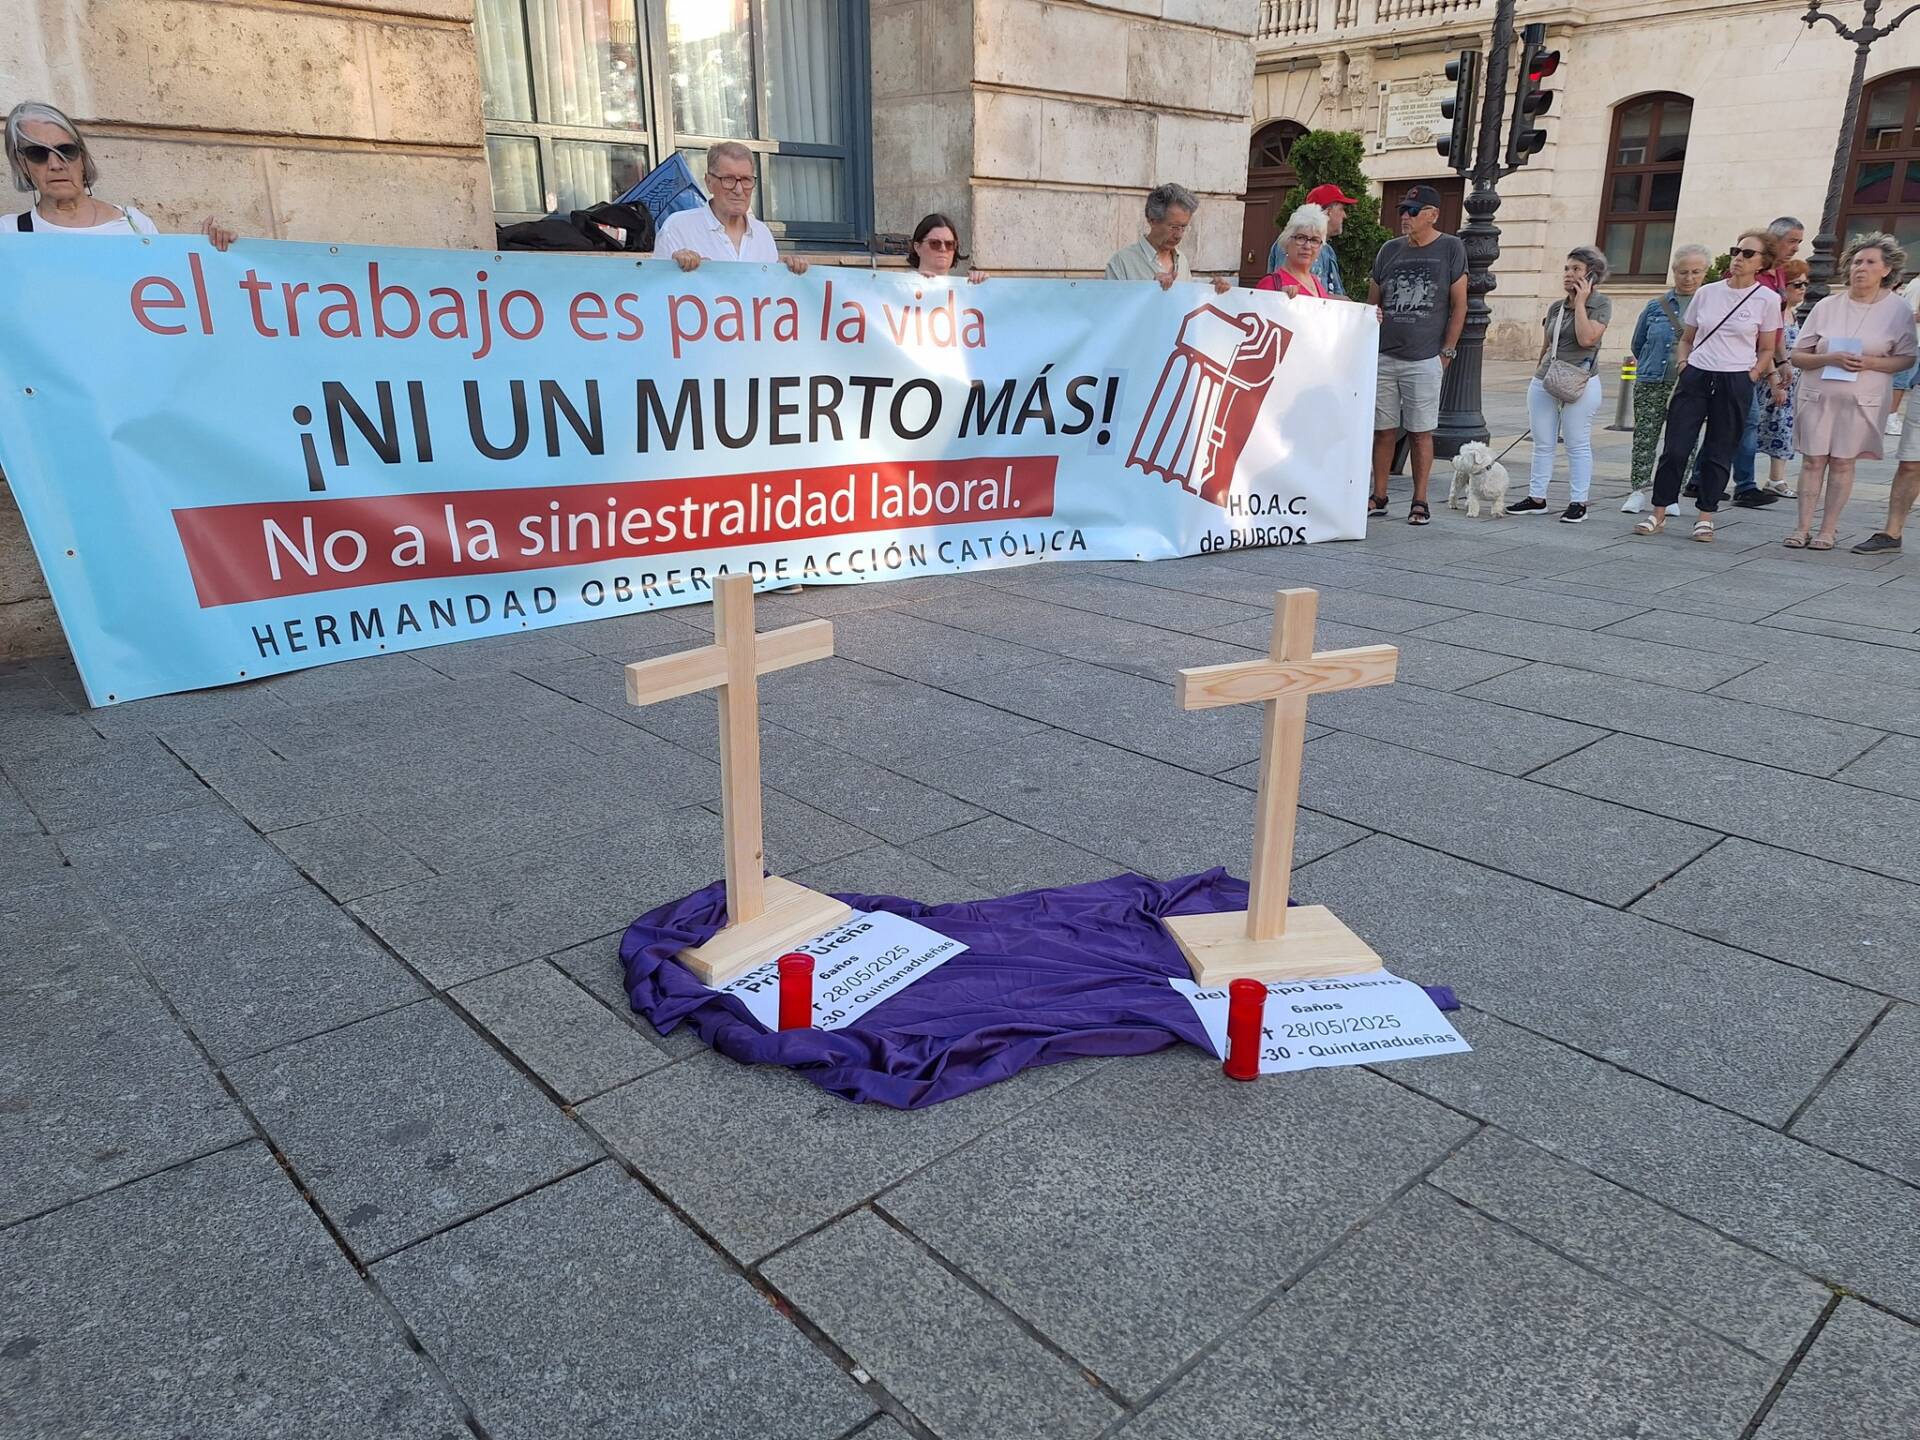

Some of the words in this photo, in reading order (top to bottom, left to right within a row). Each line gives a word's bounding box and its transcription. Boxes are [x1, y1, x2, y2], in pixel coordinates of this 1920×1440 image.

[130, 252, 215, 336] el
[239, 262, 544, 360] trabajo
[569, 291, 645, 341] es
[668, 291, 799, 359] para
[820, 281, 866, 344] la
[882, 289, 987, 348] vida
[293, 380, 434, 492] ¡NI
[463, 379, 605, 460] UN
[635, 375, 943, 453] MUERTO
[958, 363, 1119, 446] MÁS!
[1229, 494, 1307, 516] H.O.A.C.
[262, 516, 368, 581] No
[391, 525, 426, 567] a
[444, 504, 500, 563] la
[519, 474, 856, 556] siniestralidad
[870, 465, 1022, 519] laboral.
[1200, 529, 1225, 552] de
[1229, 526, 1307, 550] BURGOS
[251, 586, 558, 658] HERMANDAD
[748, 558, 790, 585] DE
[803, 541, 927, 578] ACCIÓN
[938, 529, 1087, 564] CATÓLICA
[809, 923, 874, 955] Ureña
[819, 954, 860, 980] 6años
[822, 945, 911, 1003] 28/05/2025
[854, 940, 954, 1003] Quintanadueñas
[1194, 990, 1228, 1001] del
[1291, 1000, 1344, 1014] 6años
[1281, 1014, 1402, 1039] 28/05/2025
[1309, 1033, 1457, 1058] Quintanadueñas
